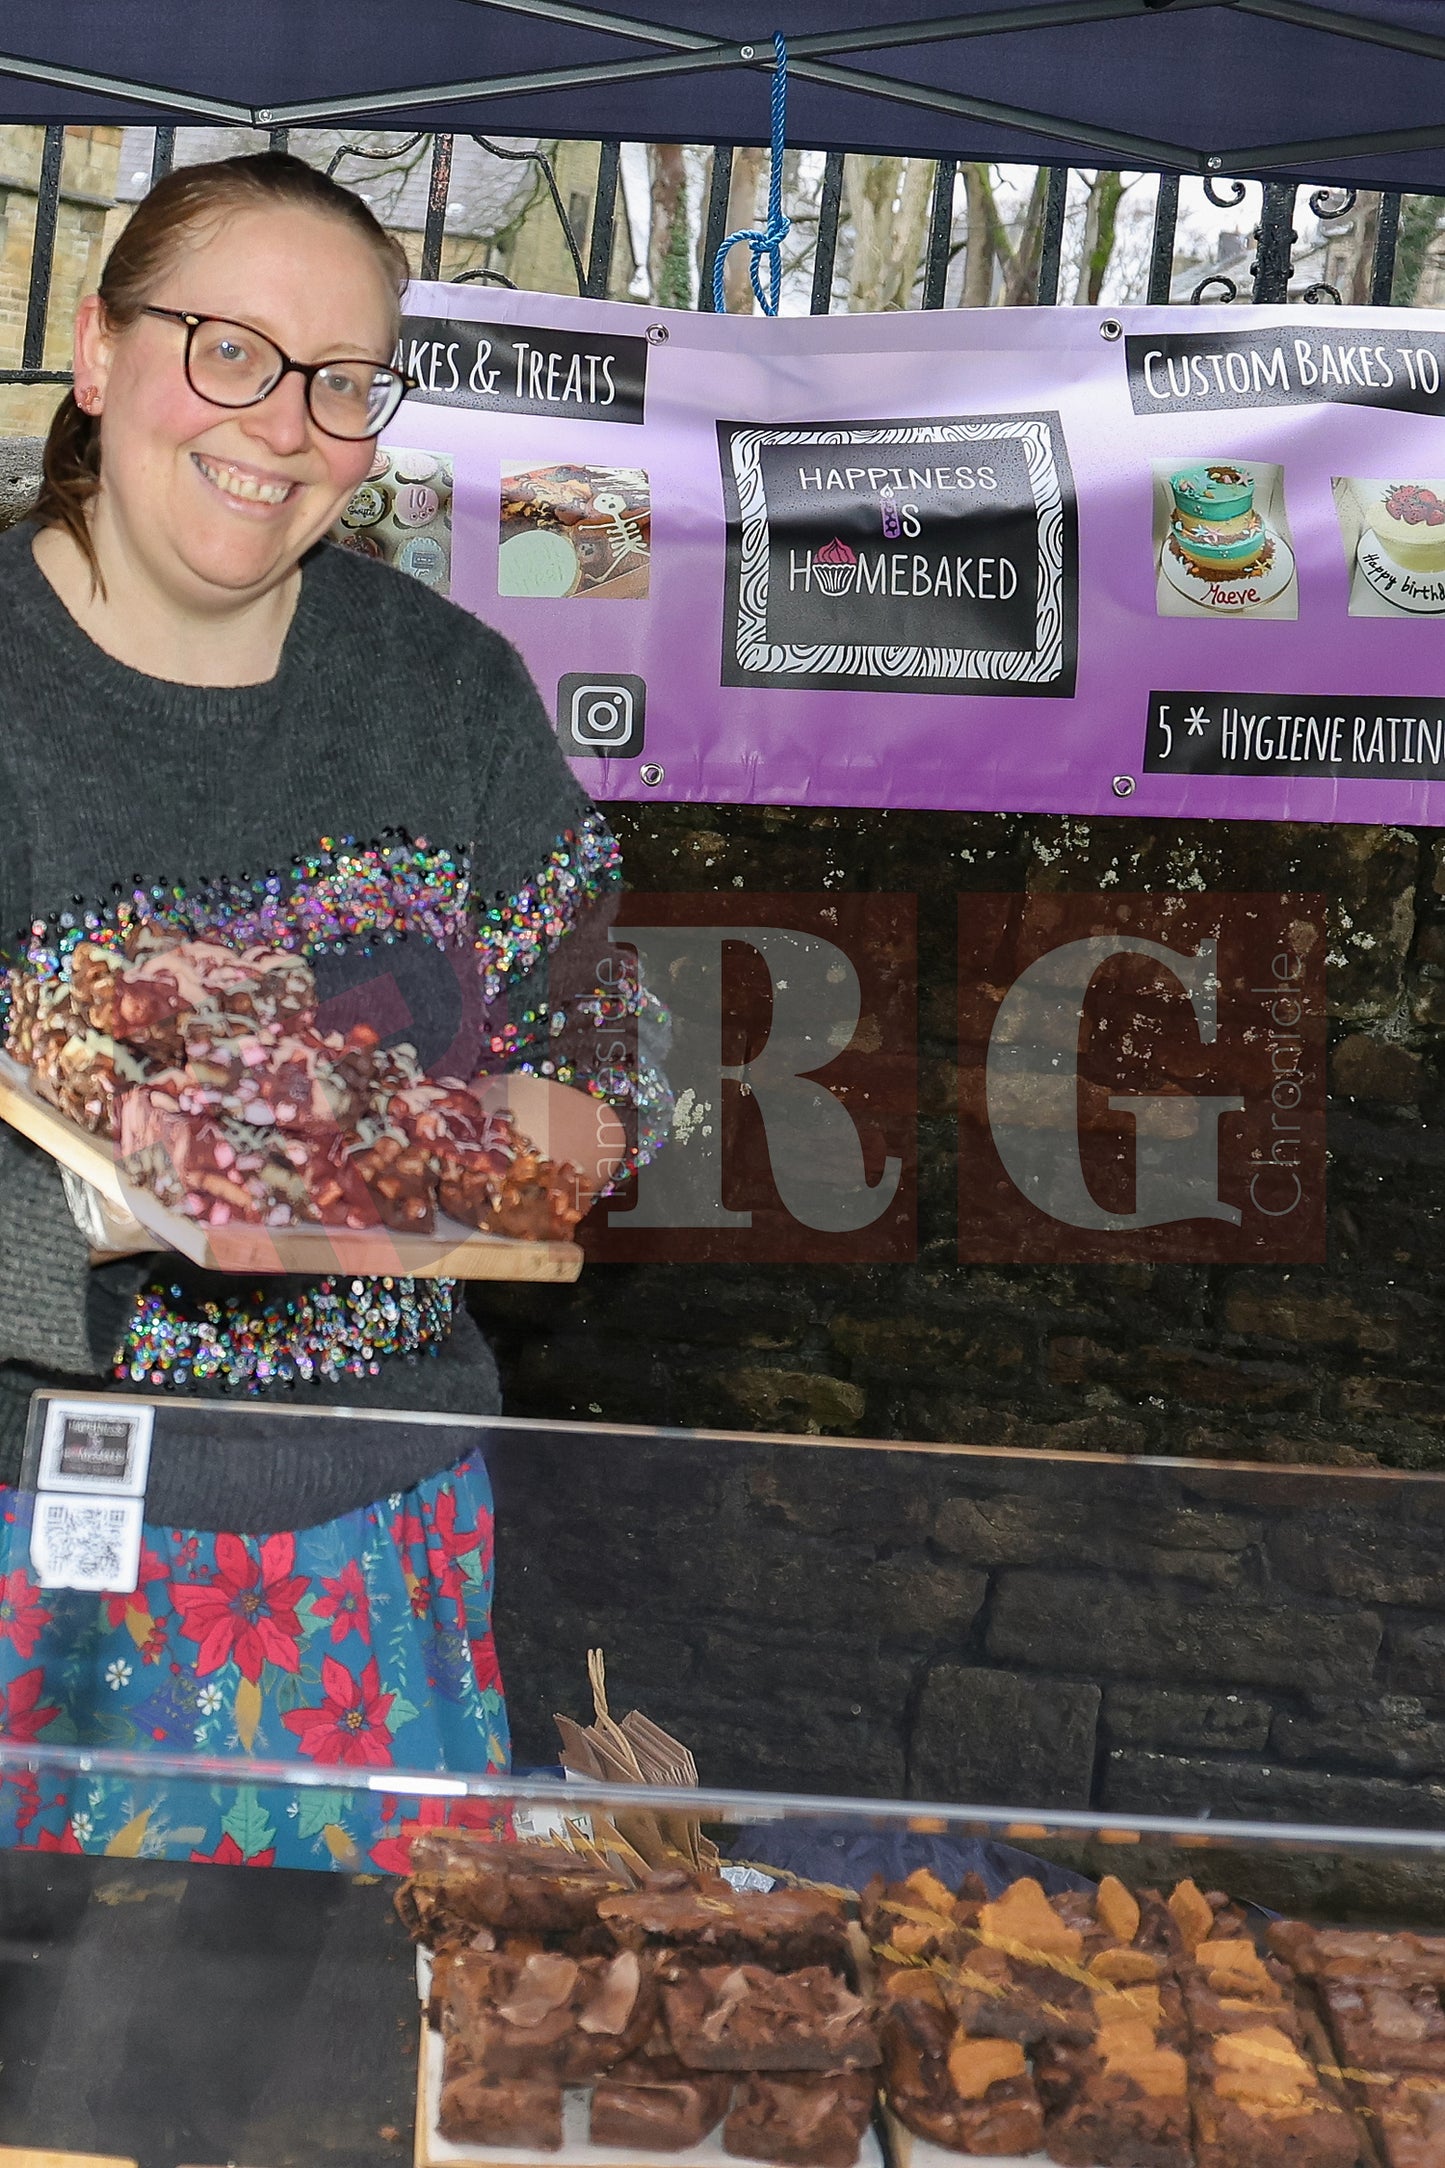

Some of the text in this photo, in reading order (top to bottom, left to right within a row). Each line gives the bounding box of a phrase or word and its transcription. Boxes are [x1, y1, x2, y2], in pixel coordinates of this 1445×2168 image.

[390, 338, 615, 405] AKES & TREATS
[1144, 340, 1440, 398] CUSTOM BAKES TO
[799, 466, 998, 491] HAPPINESS
[1200, 583, 1261, 605] Maeve
[1362, 553, 1397, 591] Happy
[1159, 705, 1173, 759] 5
[1222, 708, 1346, 763] HYGIENE
[1352, 716, 1445, 764] RATIN
